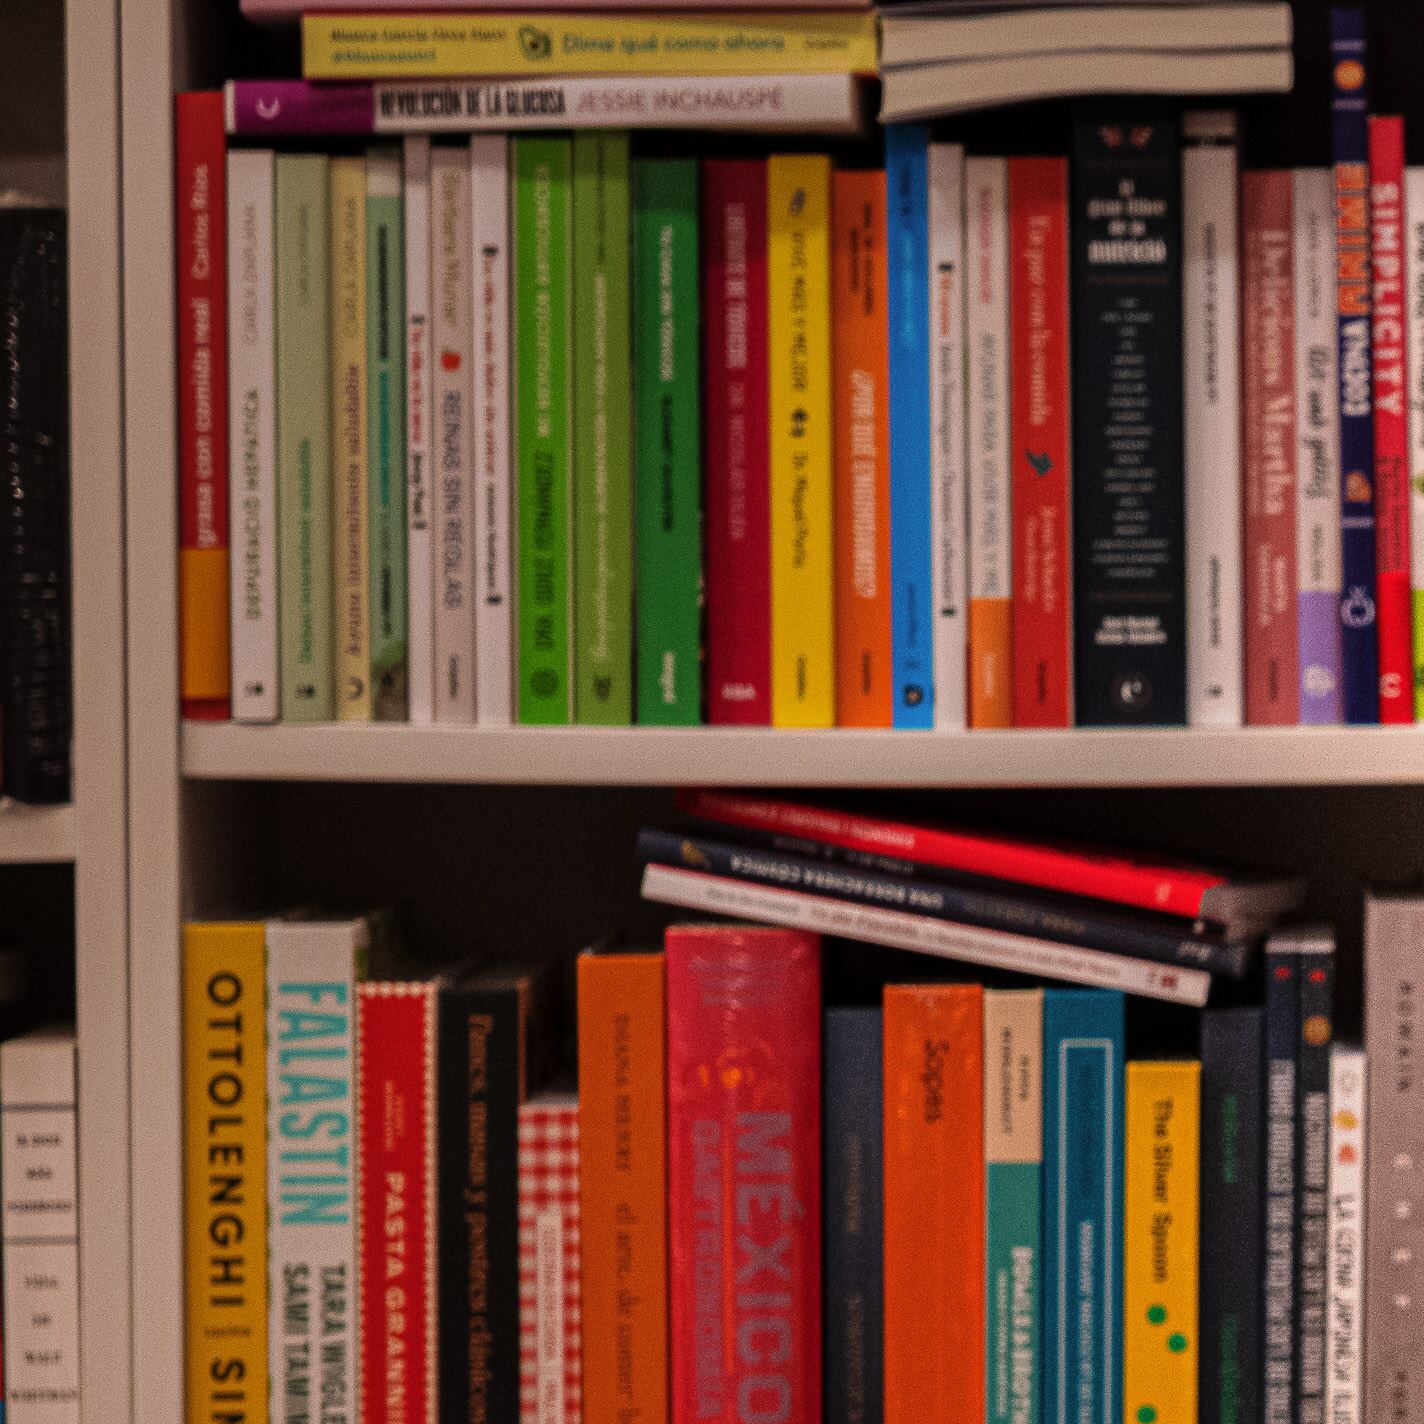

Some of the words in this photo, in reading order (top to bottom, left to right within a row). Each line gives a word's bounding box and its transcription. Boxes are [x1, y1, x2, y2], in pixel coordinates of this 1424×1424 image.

[1370, 182, 1401, 416] SIMPLICITY
[279, 982, 350, 1226] FALASTIN
[921, 1039, 952, 1126] Sopes
[1152, 1099, 1173, 1140] The
[208, 970, 248, 1307] OTTOLENGHI
[1152, 1145, 1173, 1204] Silver
[386, 1171, 406, 1277] PASTA
[1151, 1212, 1173, 1284] Spoon
[284, 1263, 310, 1334] SAMI
[321, 1263, 347, 1334] TARA
